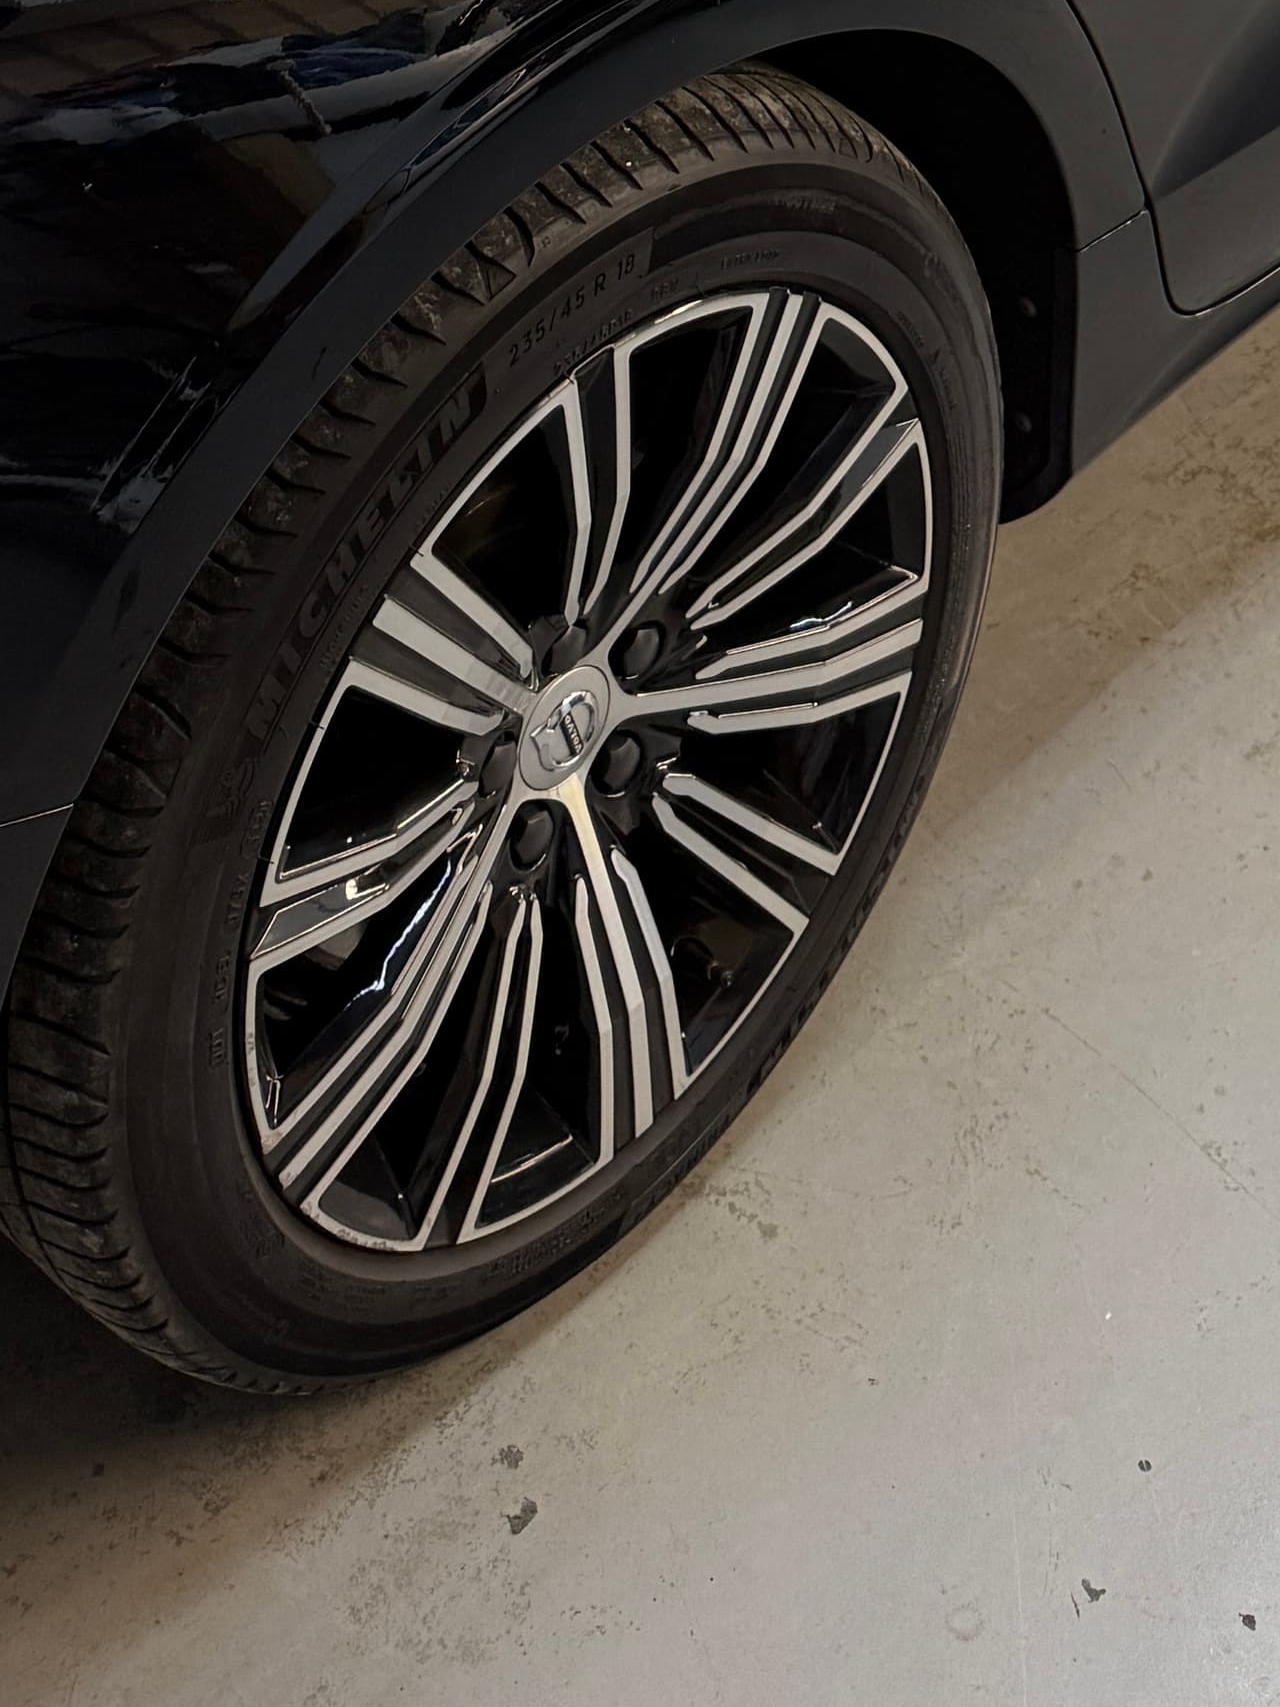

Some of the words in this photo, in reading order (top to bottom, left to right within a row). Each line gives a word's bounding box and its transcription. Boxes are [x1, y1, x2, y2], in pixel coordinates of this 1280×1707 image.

[510, 290, 584, 367] 235/45
[595, 273, 606, 296] R
[618, 254, 635, 280] 18
[242, 385, 477, 740] MICHELIN
[564, 714, 582, 754] VOLVO
